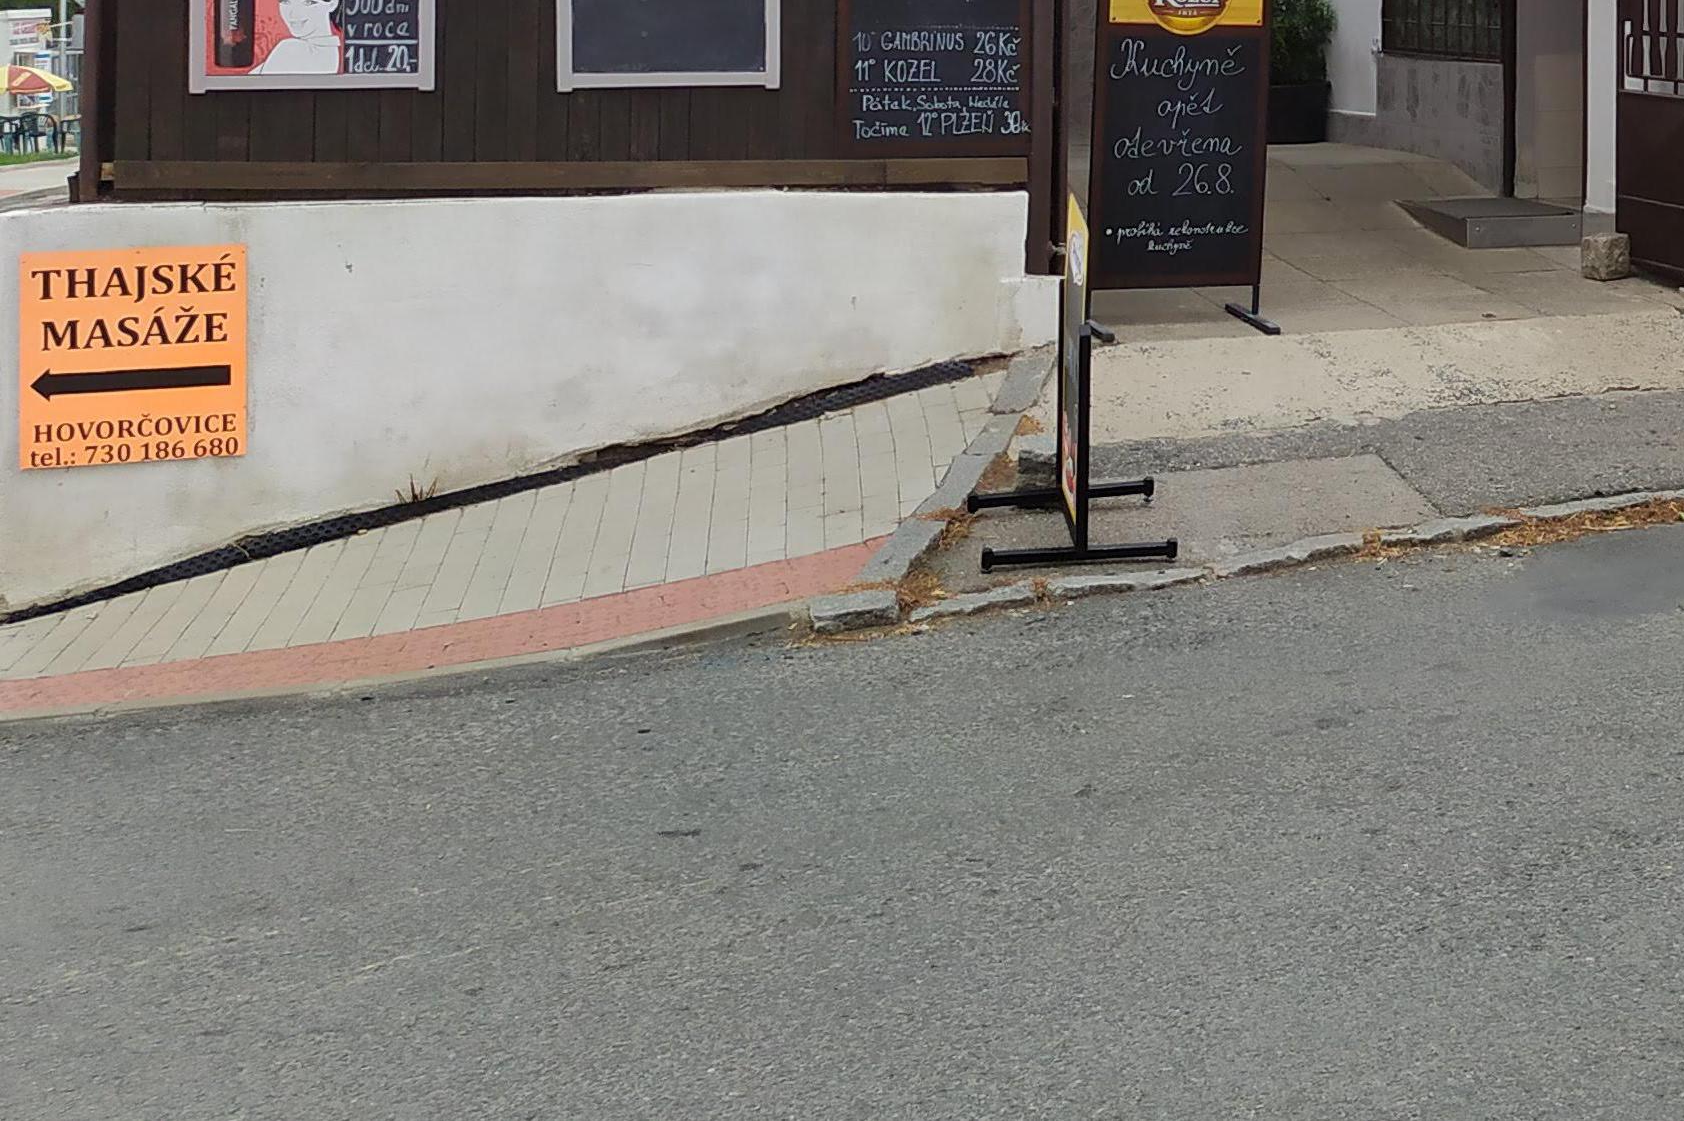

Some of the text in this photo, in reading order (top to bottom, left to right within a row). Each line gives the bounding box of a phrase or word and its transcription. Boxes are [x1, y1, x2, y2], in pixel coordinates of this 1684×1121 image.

[347, 23, 355, 37] v
[881, 31, 964, 51] GAMBRINUS
[884, 59, 941, 83] KOZEL
[1110, 39, 1245, 91] Kuchyně
[1158, 87, 1223, 129] opět
[852, 119, 910, 139] Točíme
[1114, 127, 1242, 159] otevřena
[1127, 169, 1158, 196] od
[31, 253, 236, 303] THAJSKÉ
[41, 306, 228, 351] MASÁŽE
[33, 413, 237, 443] HOVORČOVICE
[30, 437, 238, 467] tel.: 730 186 680
